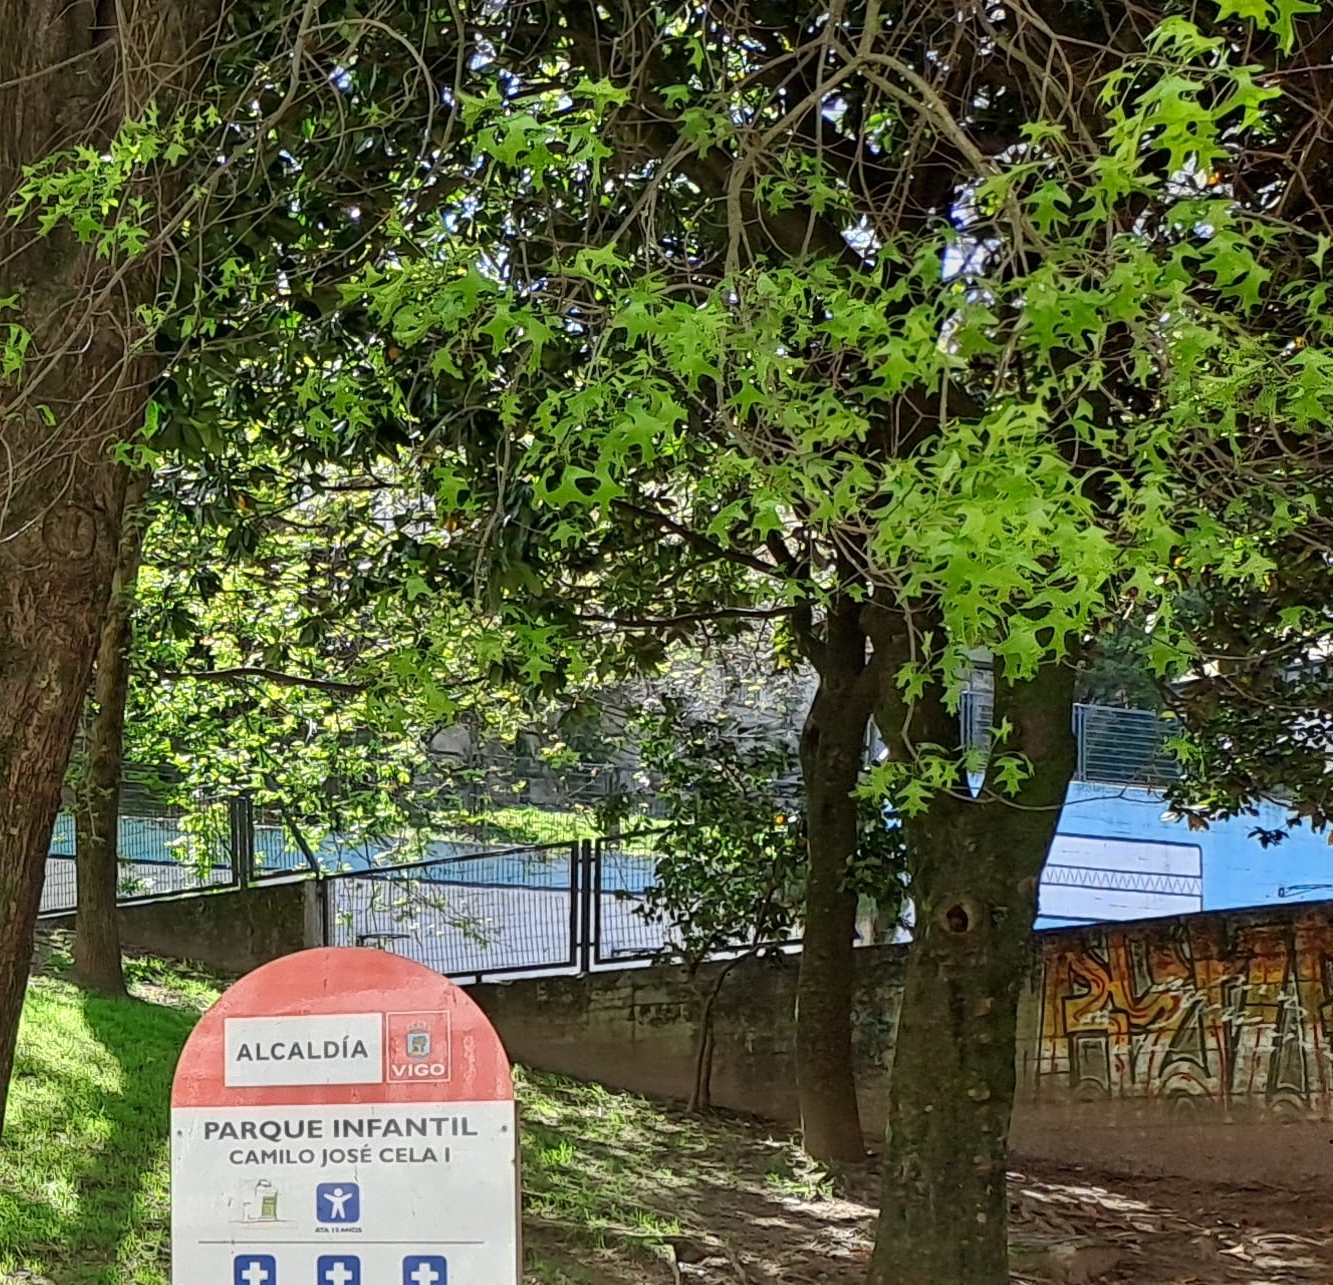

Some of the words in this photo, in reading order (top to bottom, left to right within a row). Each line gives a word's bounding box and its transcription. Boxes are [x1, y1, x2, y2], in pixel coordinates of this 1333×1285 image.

[236, 1035, 369, 1062] ALCALDÍA
[391, 1063, 446, 1077] VIGO
[204, 1119, 323, 1142] PARQUE
[333, 1117, 478, 1138] INFANTIL
[229, 1148, 315, 1165] CAMILO
[320, 1143, 373, 1167] JOSÉ
[379, 1147, 438, 1163] CELA
[444, 1147, 451, 1163] I
